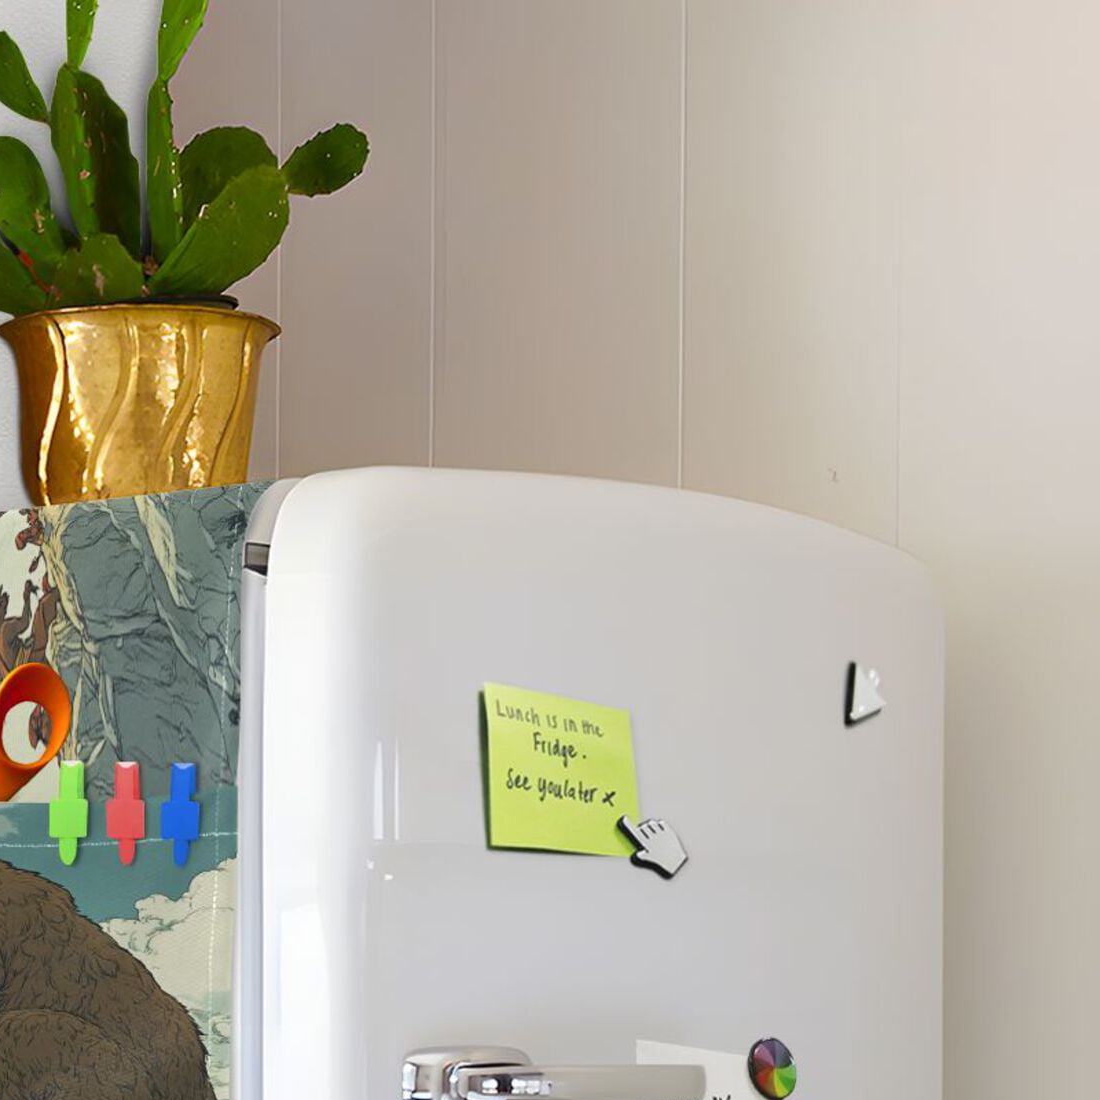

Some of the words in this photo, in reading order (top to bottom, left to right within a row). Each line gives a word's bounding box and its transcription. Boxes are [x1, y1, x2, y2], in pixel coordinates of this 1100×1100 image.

[495, 699, 541, 727] Lunch
[563, 718, 578, 733] in
[582, 719, 604, 738] the
[506, 768, 532, 790] See
